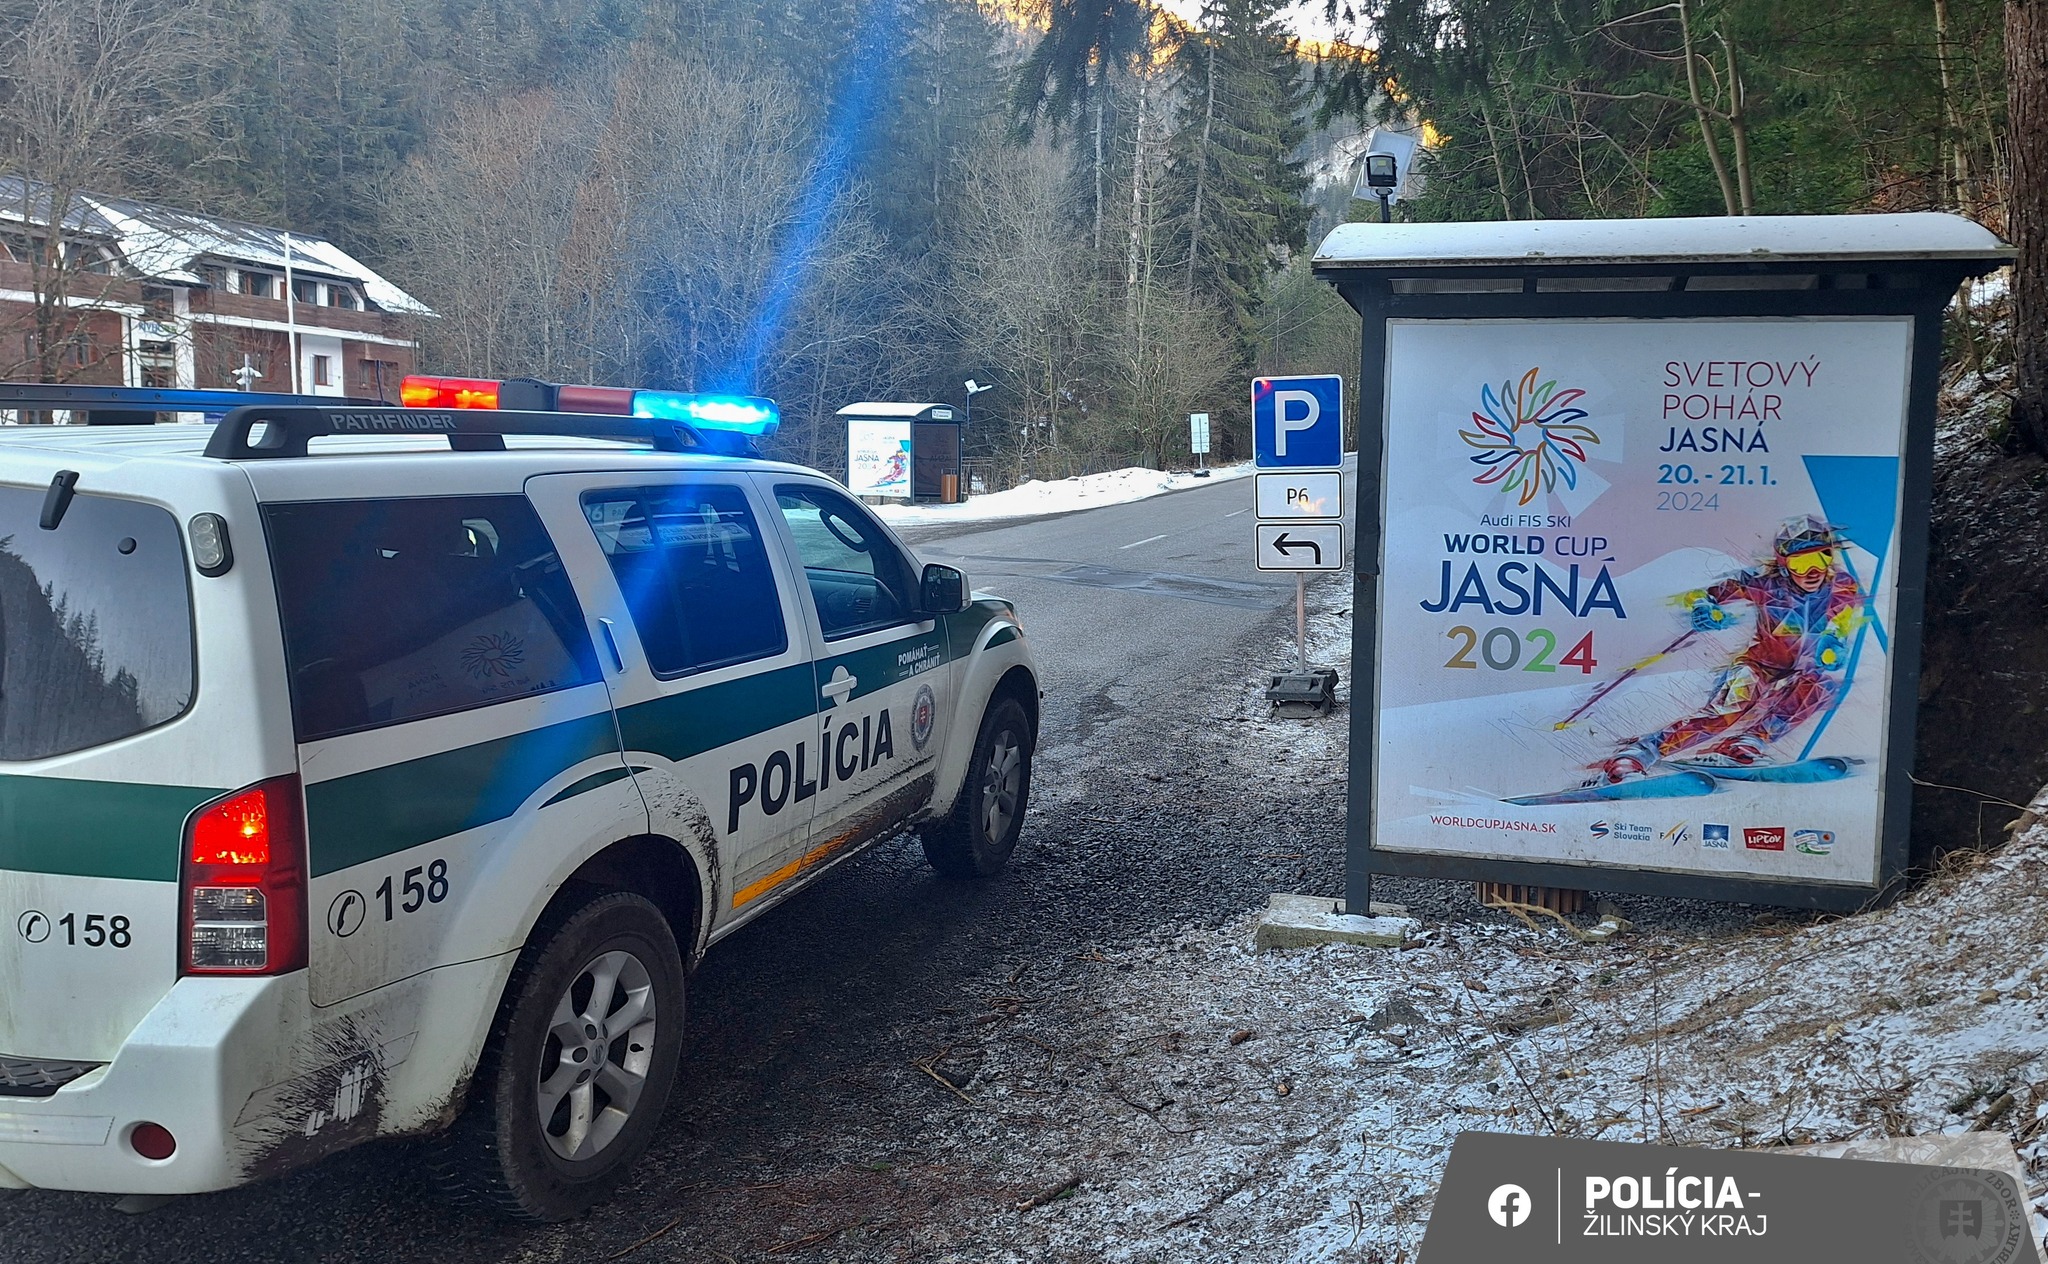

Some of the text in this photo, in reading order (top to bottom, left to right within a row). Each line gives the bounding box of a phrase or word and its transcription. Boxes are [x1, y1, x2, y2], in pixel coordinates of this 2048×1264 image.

[1663, 354, 1820, 387] SVETOVÝ
[1663, 388, 1782, 420] POHÁR
[329, 414, 457, 430] PATHFINDER
[1275, 390, 1320, 457] P
[1659, 421, 1769, 453] JASNÁ
[1286, 488, 1309, 505] P6
[1656, 491, 1719, 511] 2024
[1480, 514, 1571, 528] Audi FIS SKI
[1444, 533, 1608, 556] WORLD CUP
[1419, 556, 1627, 619] JASNÁ
[898, 643, 928, 667] POMÁHAŤ
[1444, 626, 1598, 674] 2024
[909, 664, 914, 677] A
[727, 708, 894, 835] POLÍCIA
[1430, 815, 1557, 834] WORLDCUPJASNA.SK
[1614, 822, 1652, 833] Ski Team
[1614, 832, 1651, 841] Slovakia
[375, 859, 450, 923] 158
[59, 912, 132, 949] 158
